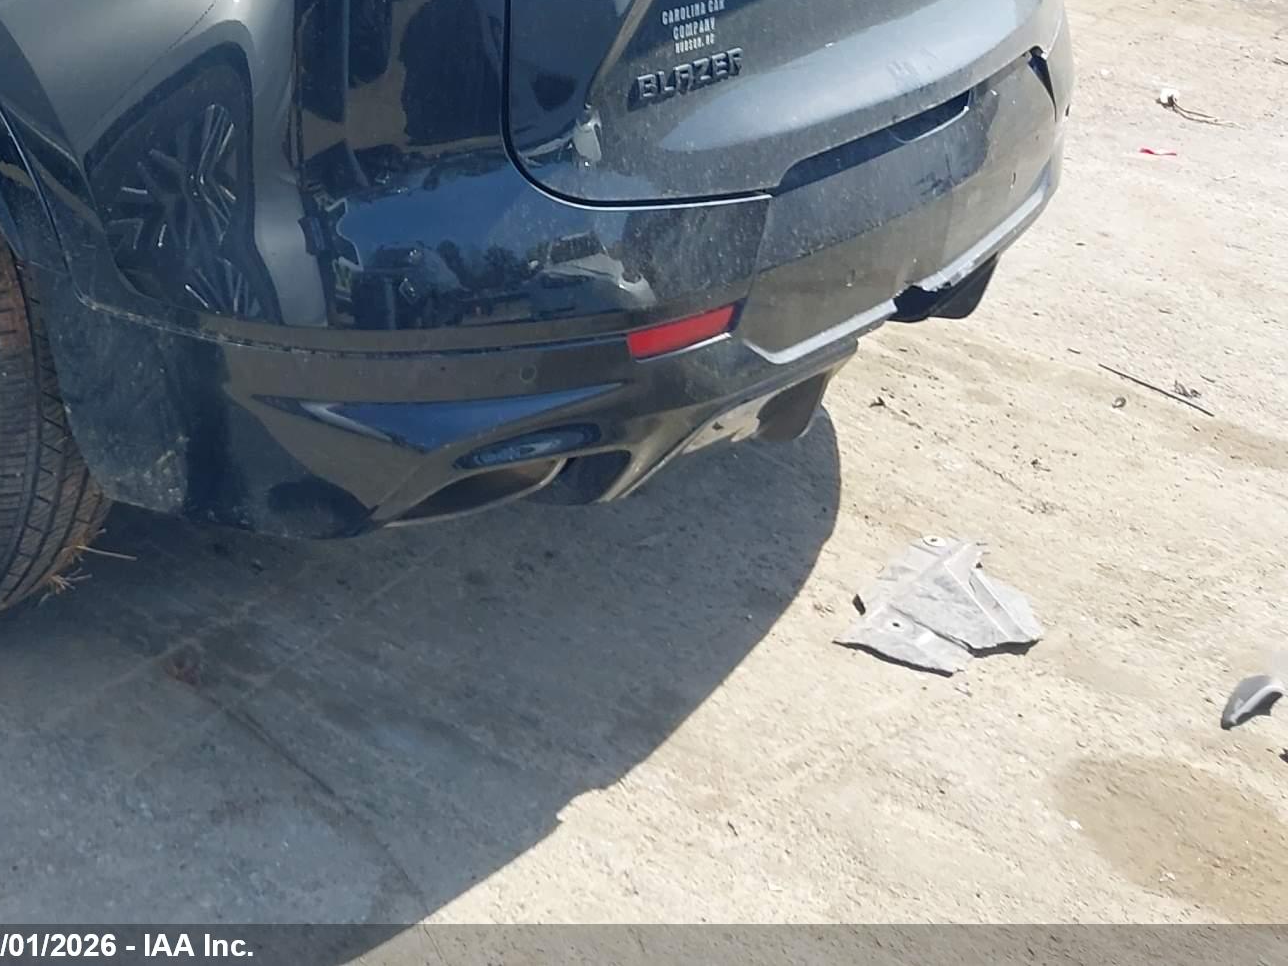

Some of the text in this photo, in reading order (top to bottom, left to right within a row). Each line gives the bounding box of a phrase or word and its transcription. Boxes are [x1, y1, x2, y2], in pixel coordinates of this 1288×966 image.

[661, 1, 706, 25] CAROLINA
[673, 17, 716, 40] COMPANY
[636, 47, 744, 100] BLAZER
